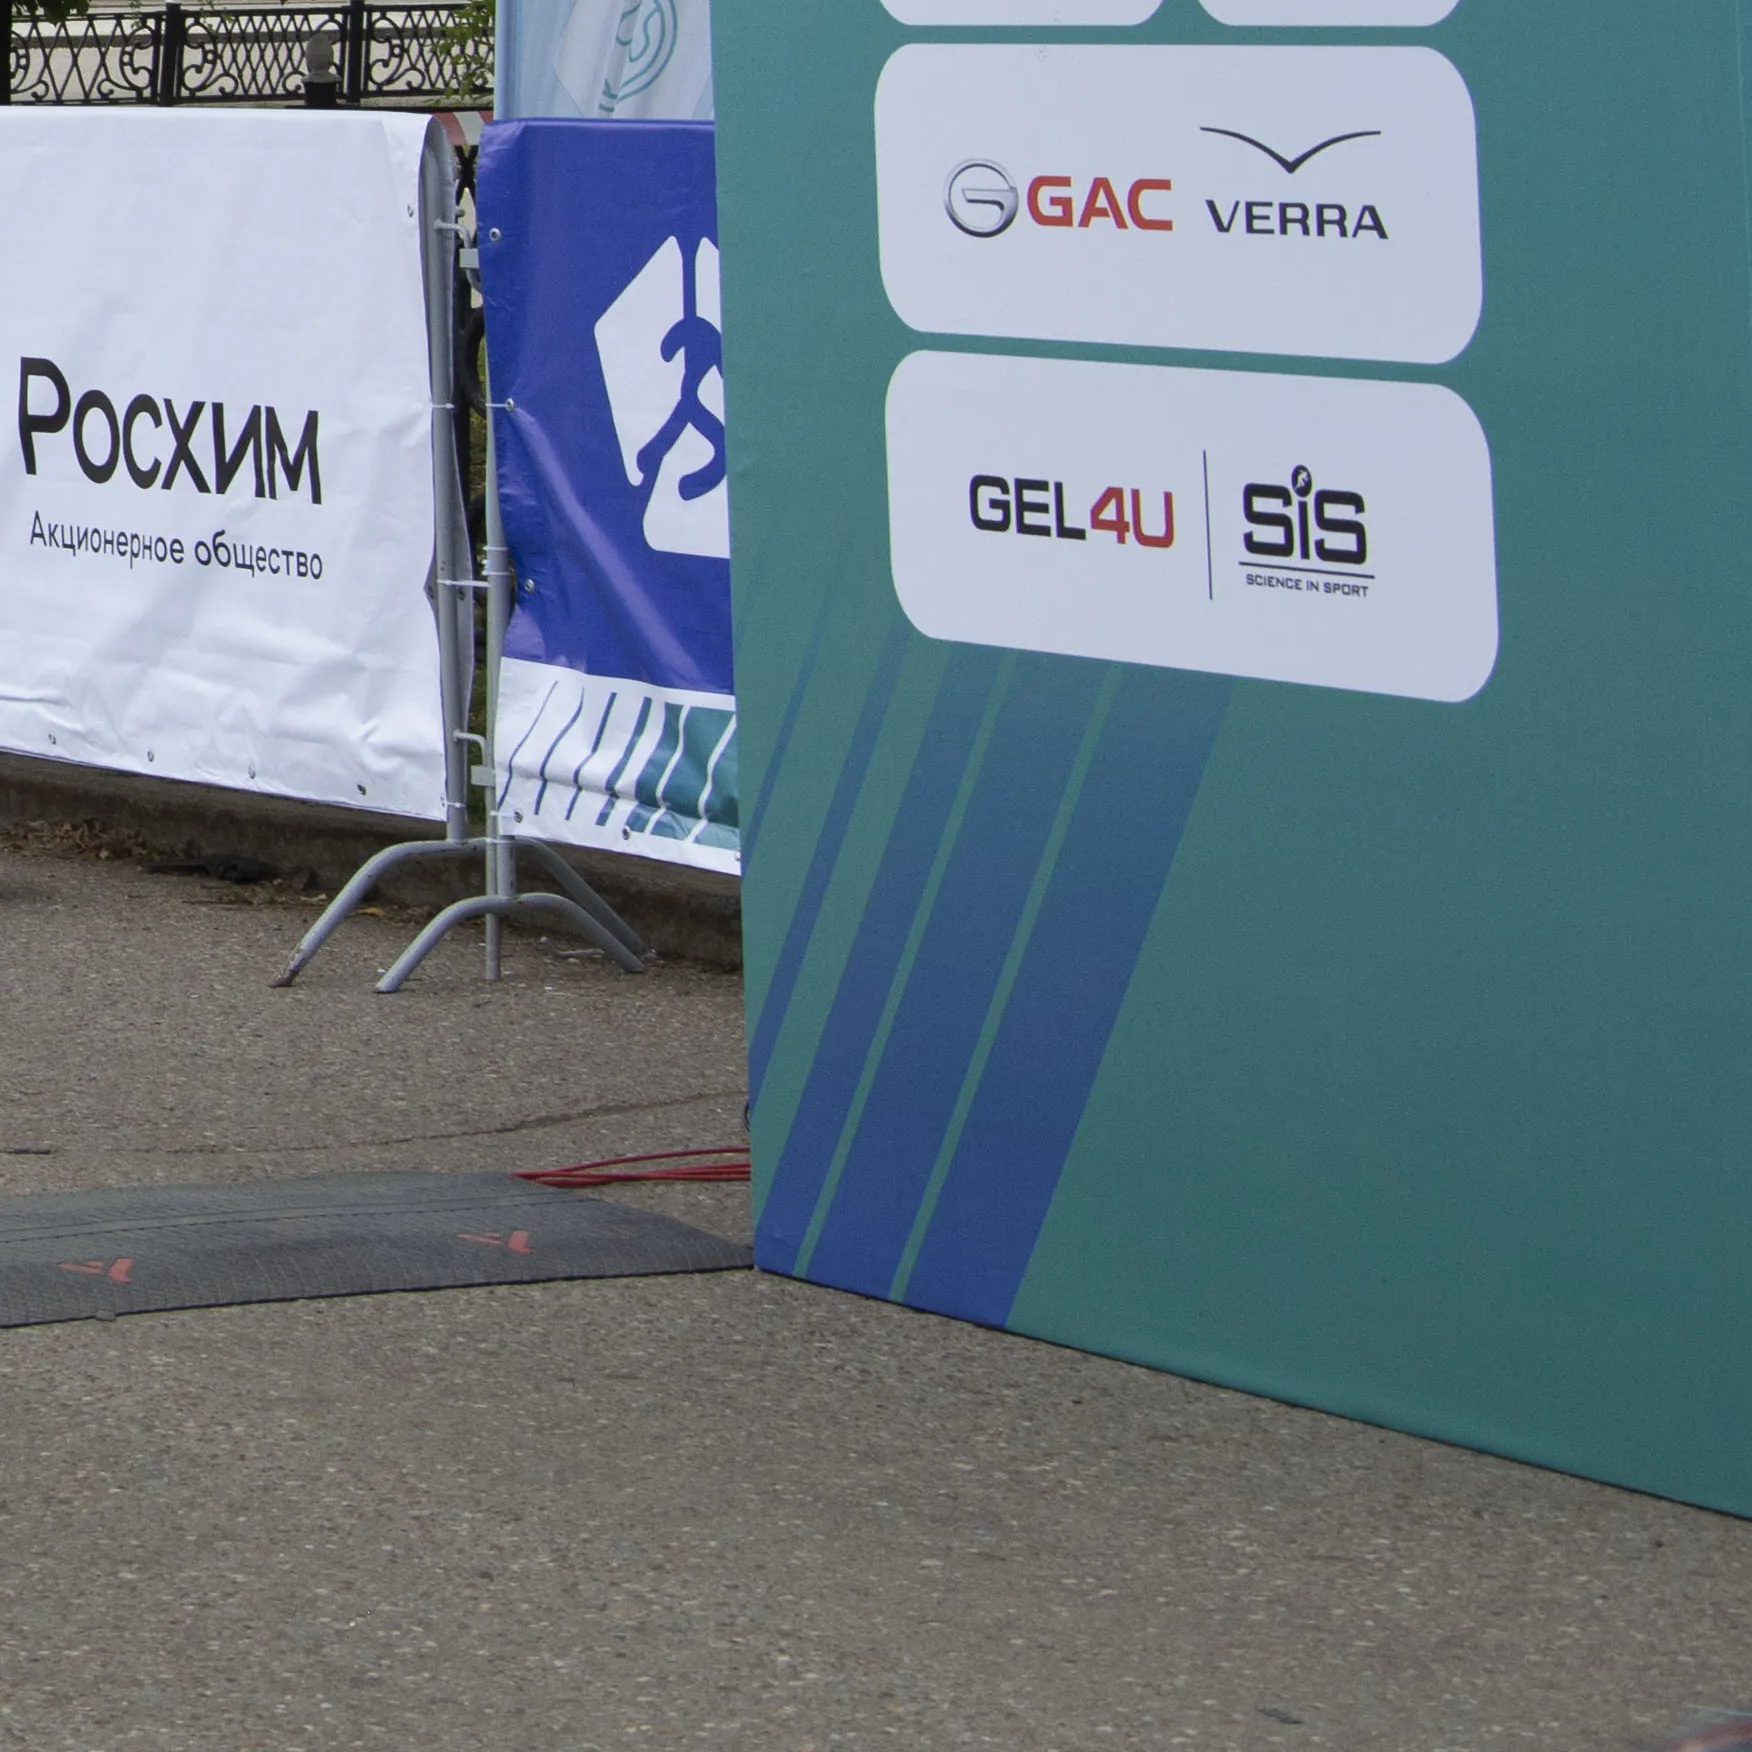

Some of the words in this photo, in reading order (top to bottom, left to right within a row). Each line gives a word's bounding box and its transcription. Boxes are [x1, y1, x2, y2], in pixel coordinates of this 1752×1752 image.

[1027, 175, 1173, 231] GAC
[1205, 199, 1388, 239] VERRA
[29, 509, 186, 571] Акционерное
[193, 529, 324, 583] общество
[969, 474, 1174, 549] GEL4U
[1246, 573, 1302, 590] SCIENCE
[1306, 580, 1319, 592] IN
[1324, 582, 1369, 597] SPORT
